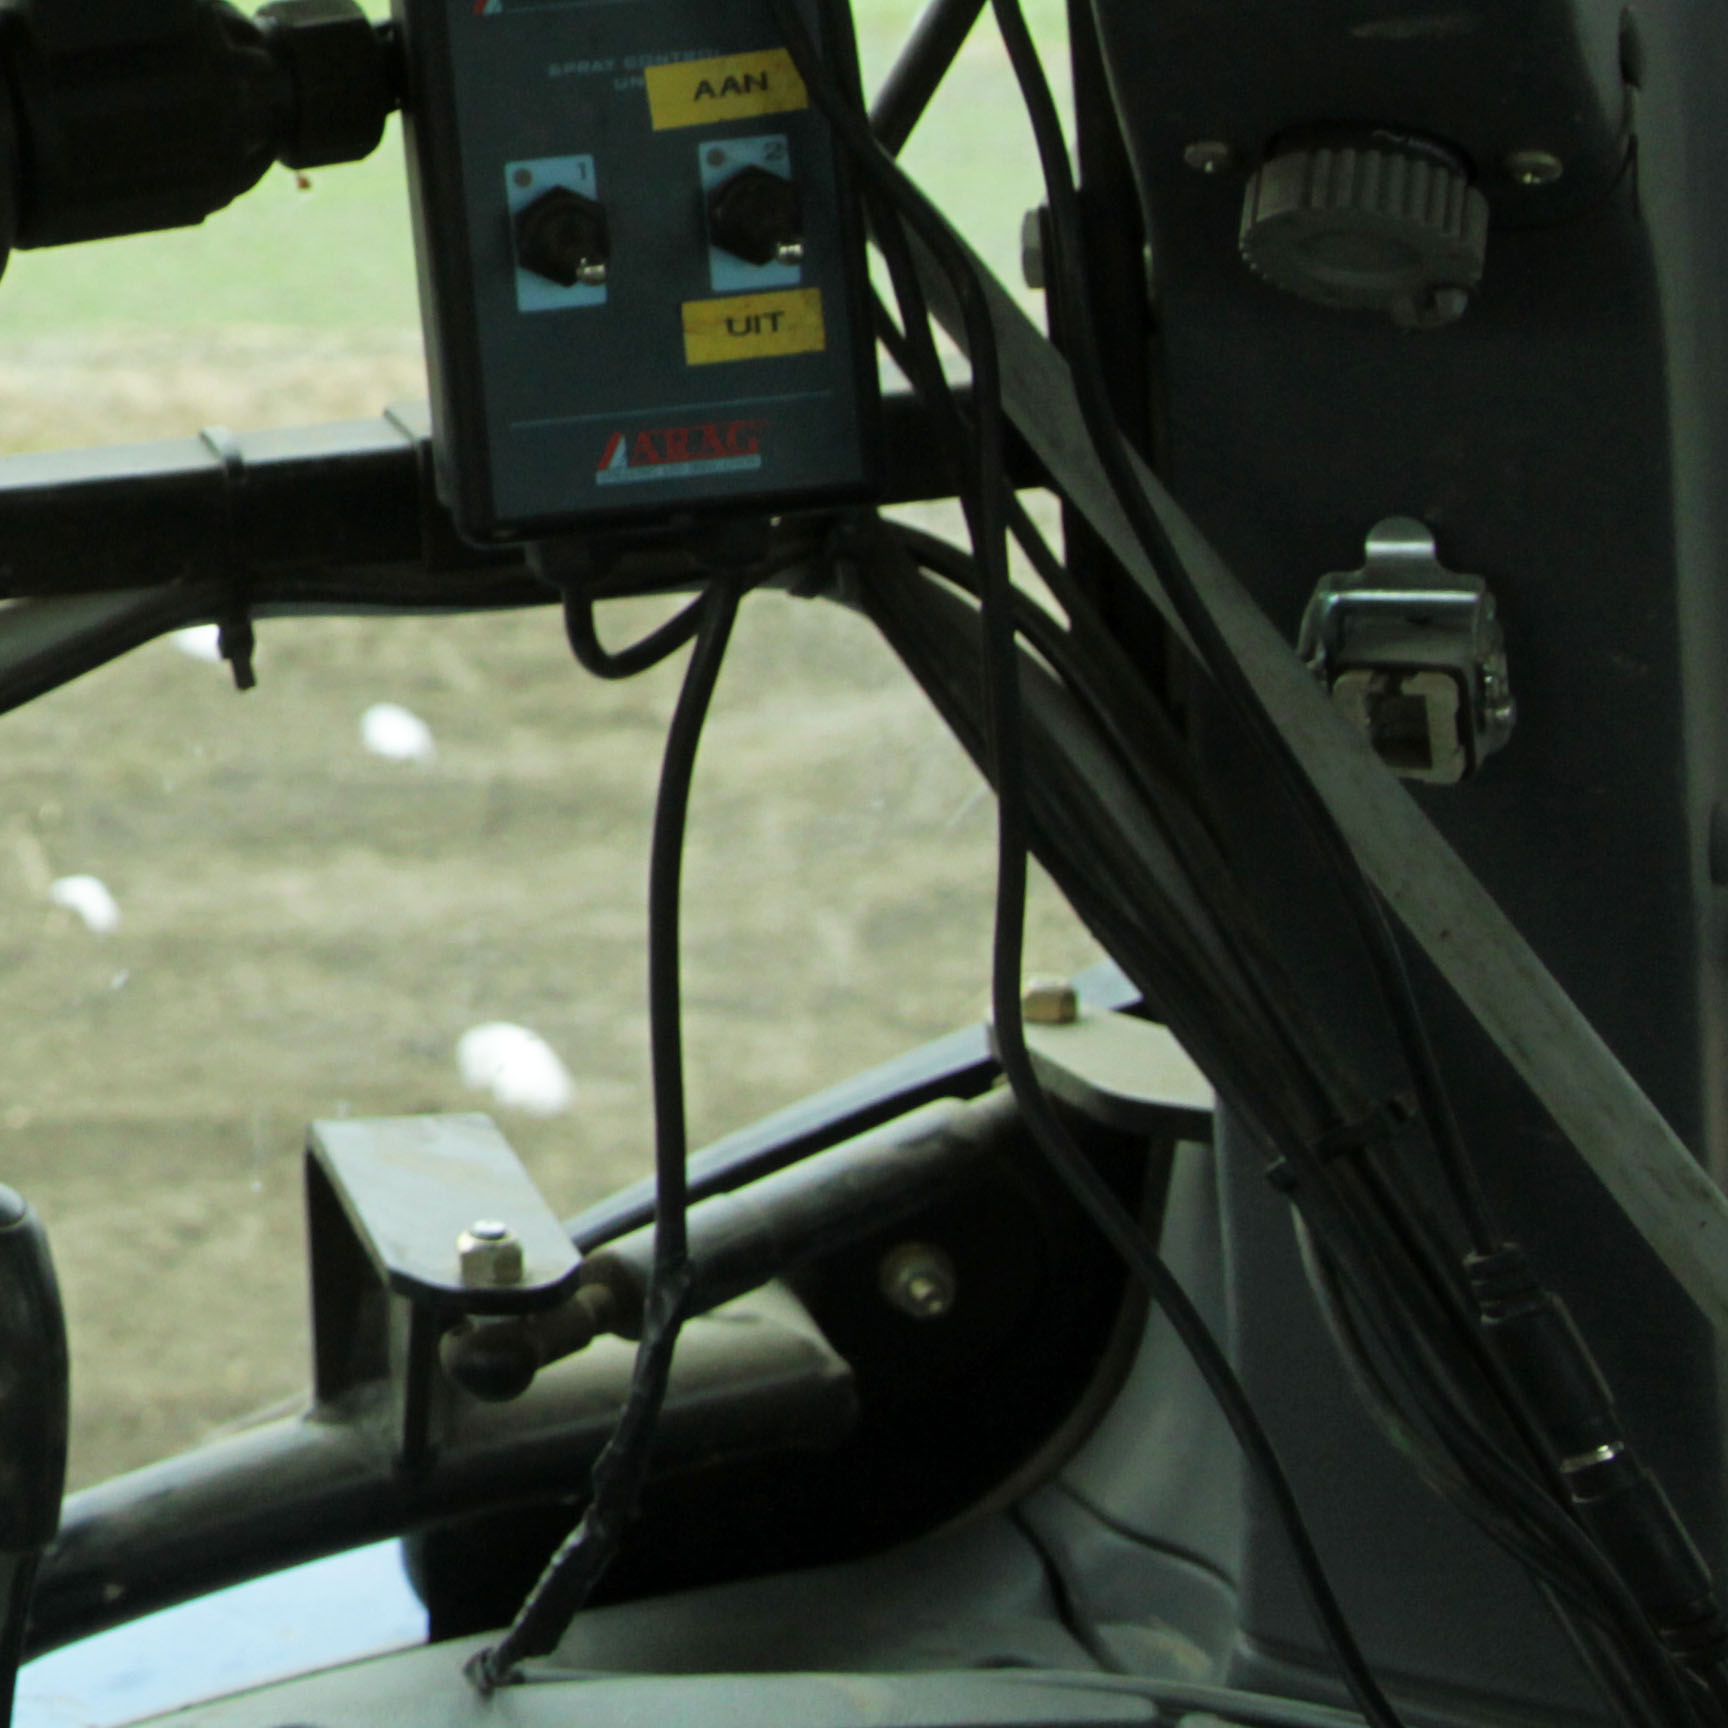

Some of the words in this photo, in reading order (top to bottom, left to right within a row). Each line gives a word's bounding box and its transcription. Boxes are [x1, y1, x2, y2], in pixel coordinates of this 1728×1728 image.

[694, 71, 769, 101] AAN
[764, 142, 783, 160] 2
[577, 162, 589, 181] 1
[726, 310, 783, 338] UIT
